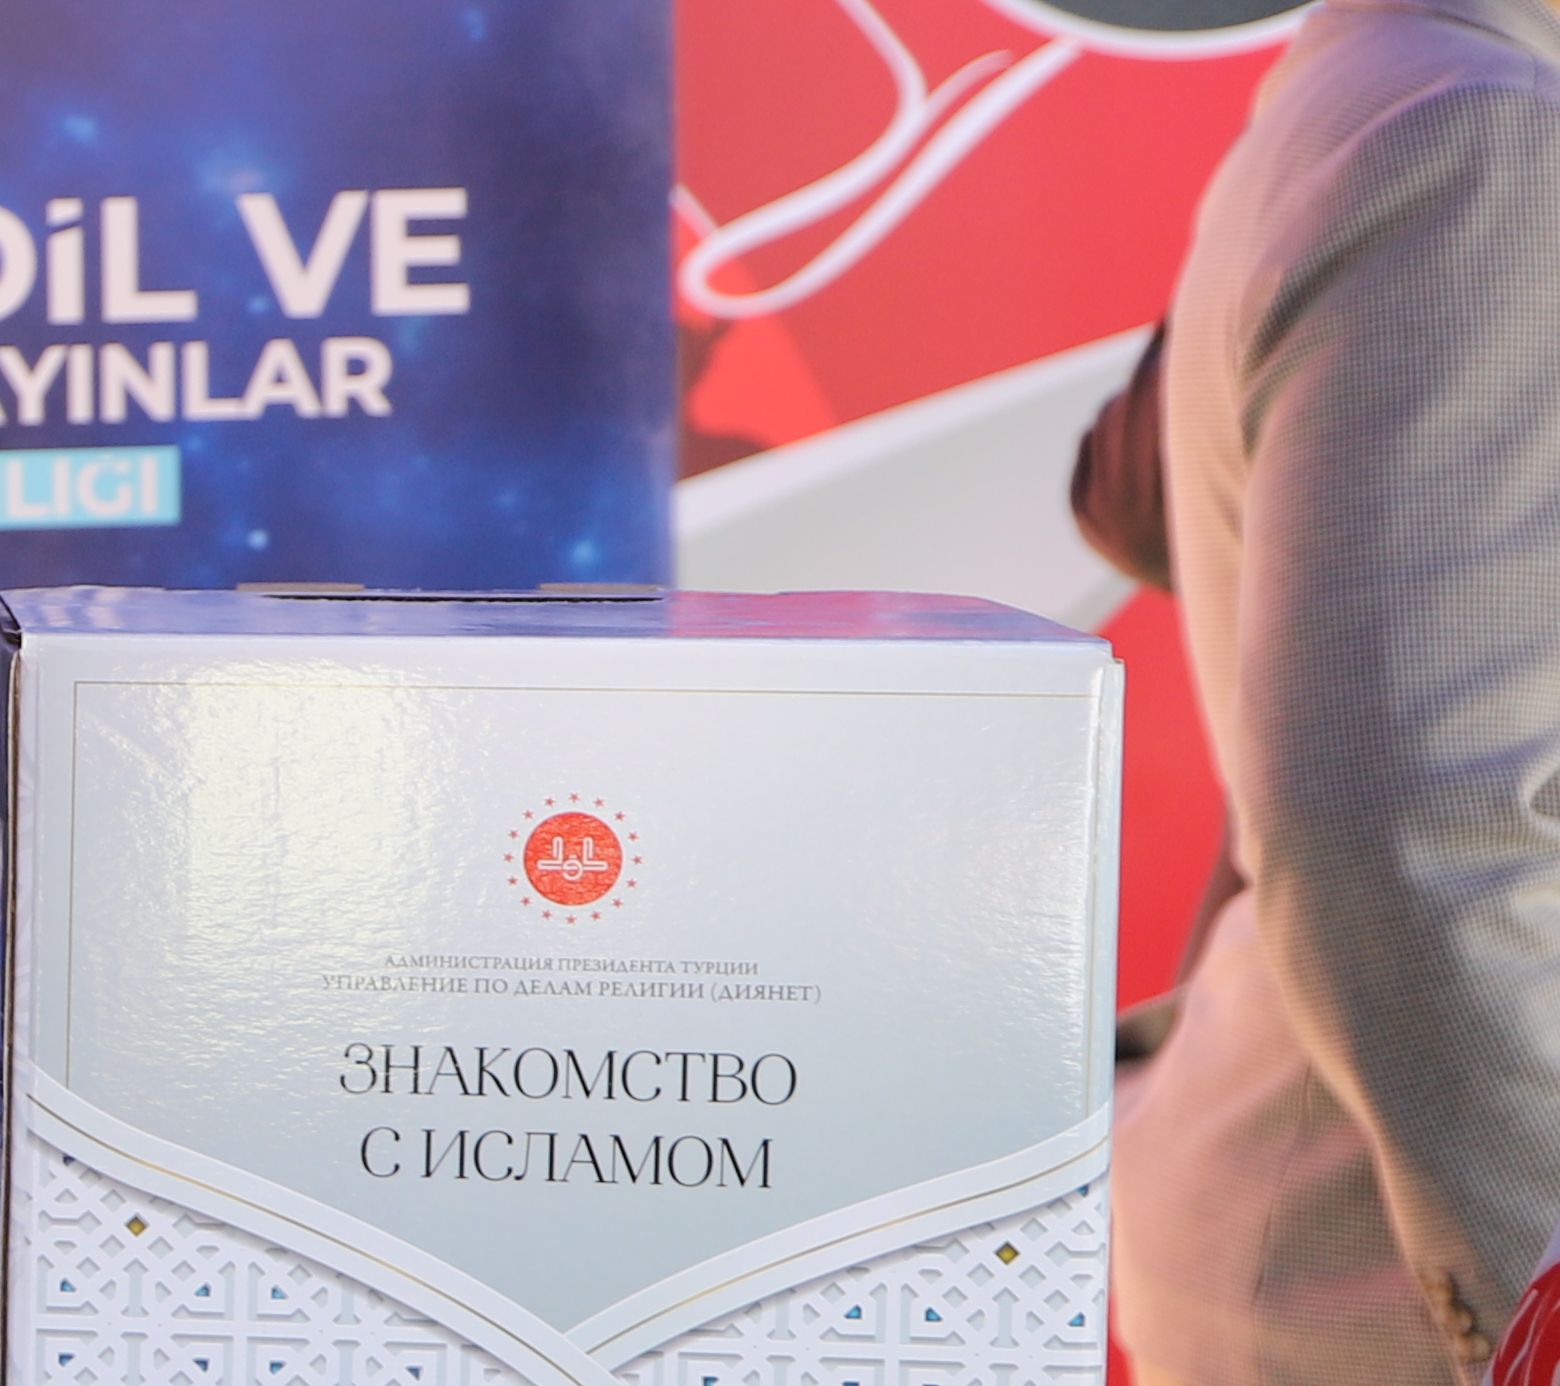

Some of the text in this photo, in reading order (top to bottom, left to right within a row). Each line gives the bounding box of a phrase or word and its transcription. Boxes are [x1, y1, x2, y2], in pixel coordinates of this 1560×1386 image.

[236, 187, 471, 319] VE
[321, 974, 822, 1005] УПРАВЛЕНИЕ ПО ДЕЛАМ РЕЛИГИИ (ДИЯНЕТ)
[384, 954, 759, 977] АДМИНИСТРАЦИЯ ПРЕЗИДЕНТА ТУРЦИИ
[339, 1042, 798, 1106] ЗНАКОМСТВО
[360, 1126, 773, 1190] С ИСЛАМОМ
